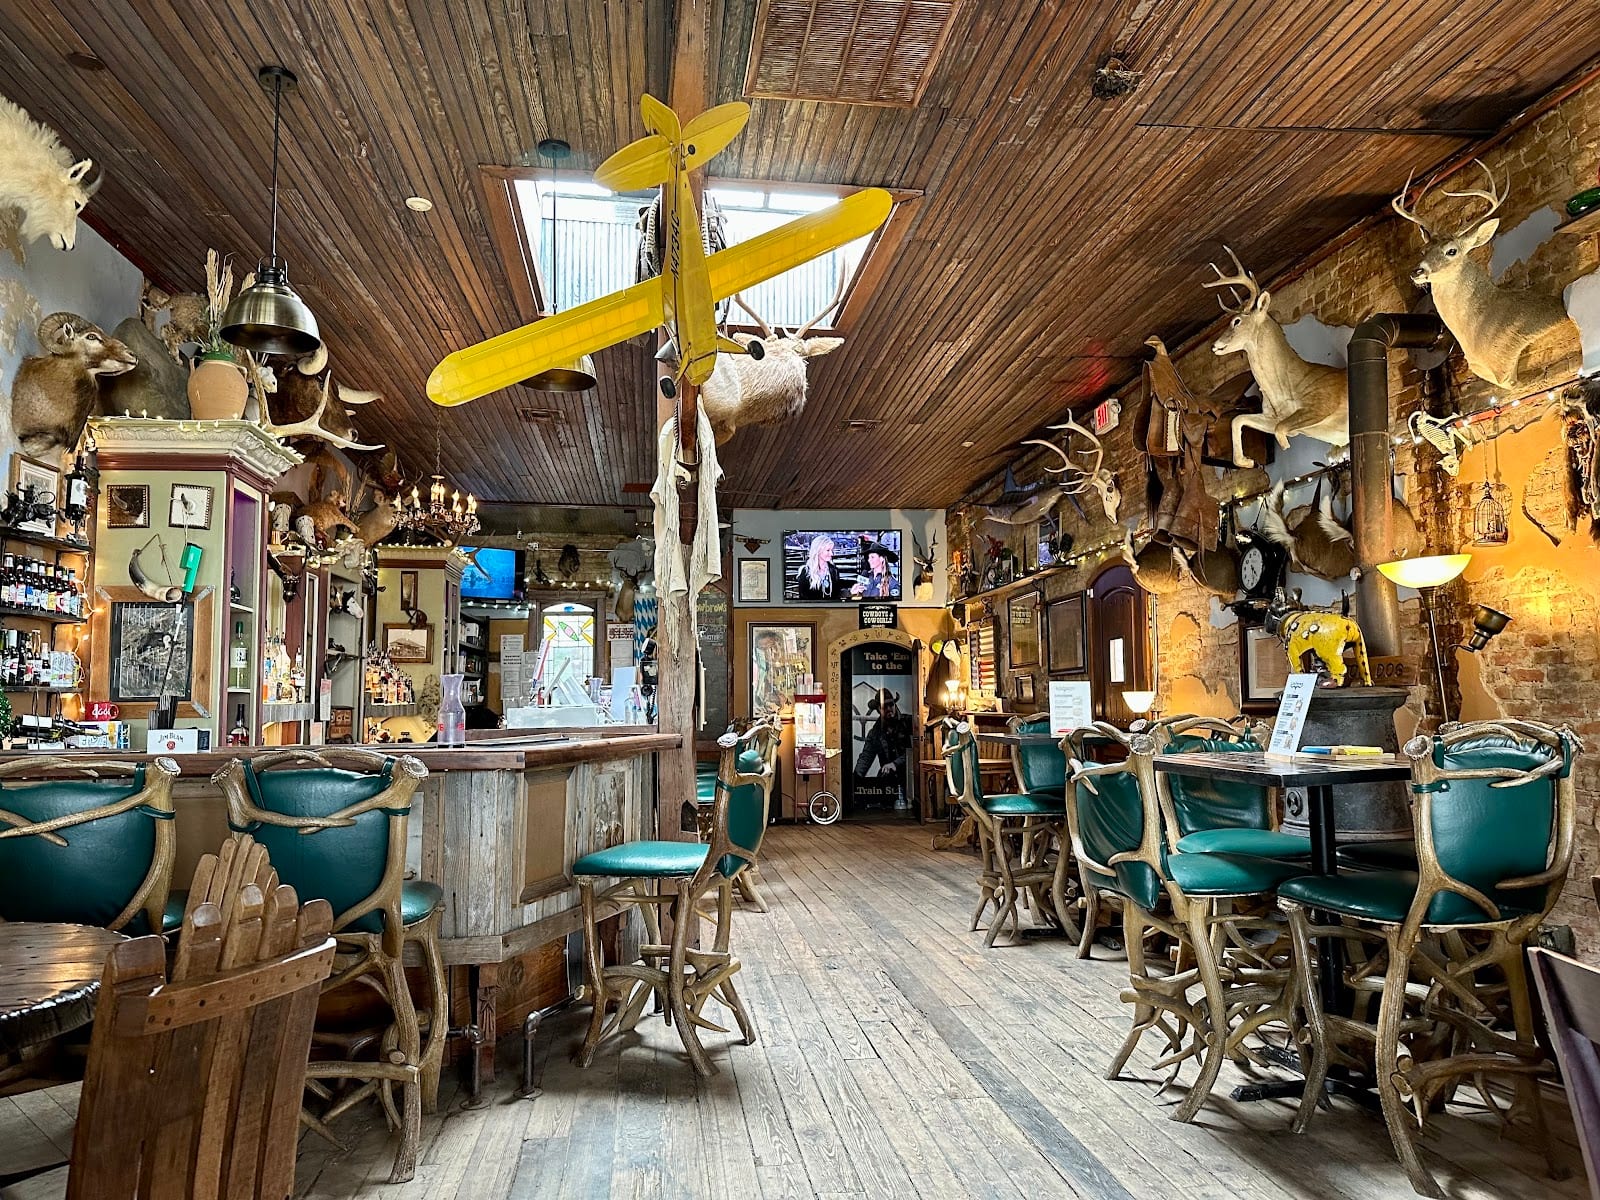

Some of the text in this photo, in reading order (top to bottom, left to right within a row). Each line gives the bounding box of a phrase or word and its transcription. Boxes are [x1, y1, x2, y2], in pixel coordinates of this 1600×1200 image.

[862, 610, 889, 618] COWBOYS
[863, 652, 888, 661] Take
[871, 662, 903, 670] to the
[856, 786, 883, 795] Train
